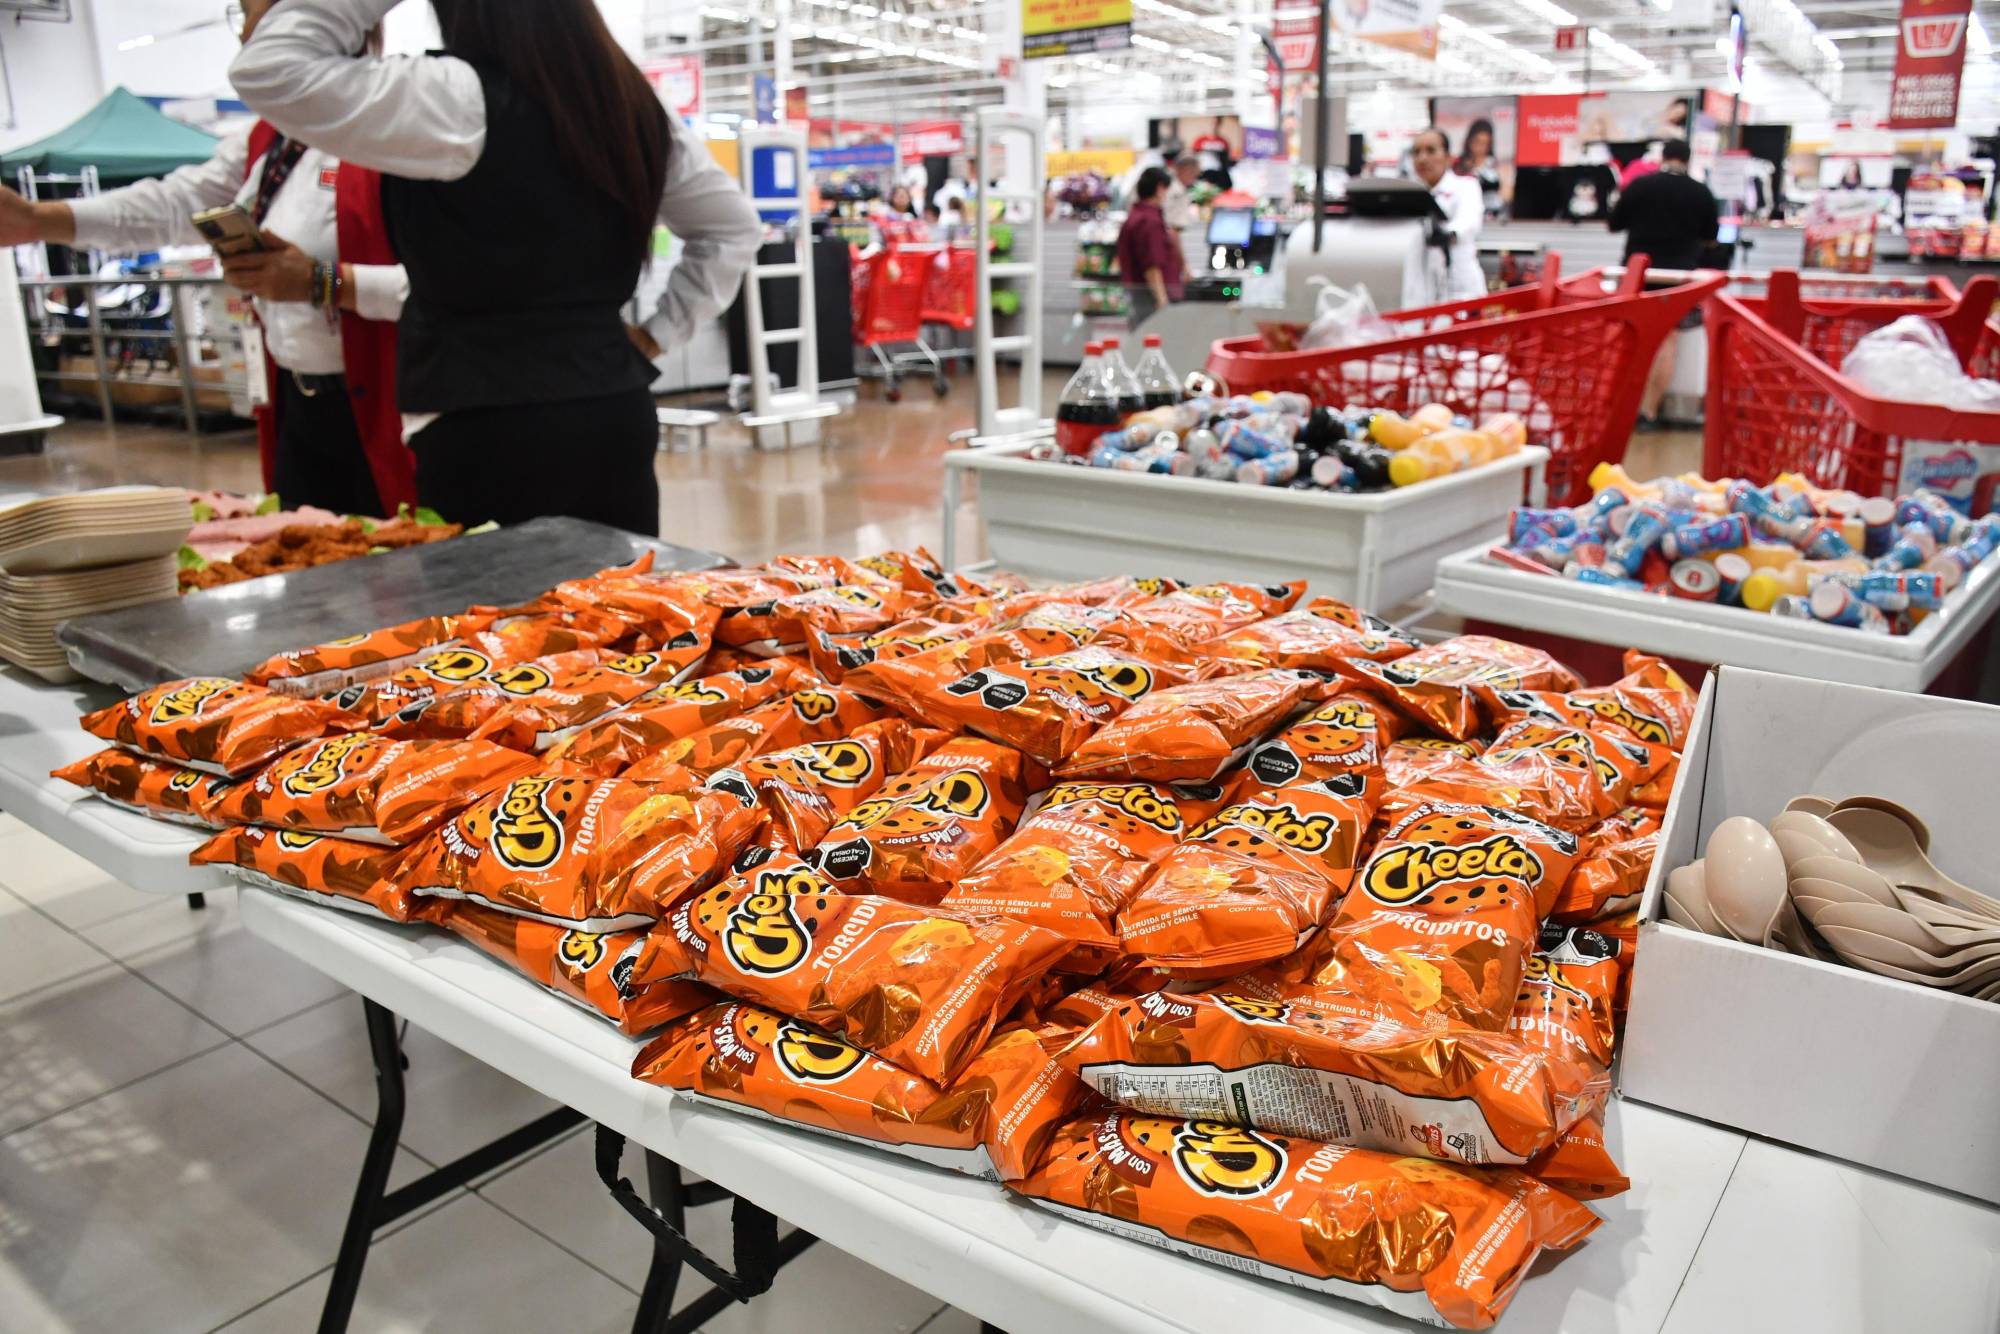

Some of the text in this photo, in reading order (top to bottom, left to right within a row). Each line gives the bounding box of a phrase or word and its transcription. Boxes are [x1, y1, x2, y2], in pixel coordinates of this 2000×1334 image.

[1005, 906, 1029, 915] CHILE
[1139, 923, 1166, 935] QUESO
[1174, 912, 1199, 925] CHILE
[689, 937, 706, 953] con
[935, 984, 967, 1019] EXTRUIDA
[963, 974, 975, 986] DE
[995, 943, 1006, 953] DE
[955, 984, 977, 1009] QUESO
[1169, 1003, 1193, 1017] con
[1314, 1000, 1357, 1017] EXTRUIDA
[736, 1047, 755, 1064] con
[1013, 1080, 1040, 1112] EXTRUIDA
[1037, 1072, 1047, 1083] DE
[1014, 1103, 1033, 1126] SABOR
[1031, 1083, 1050, 1106] QUESO
[1127, 1155, 1151, 1176] con
[1492, 1224, 1511, 1248] QUESO
[1455, 1248, 1480, 1287] BOTANA
[1475, 1221, 1500, 1251] EXTRUIDA
